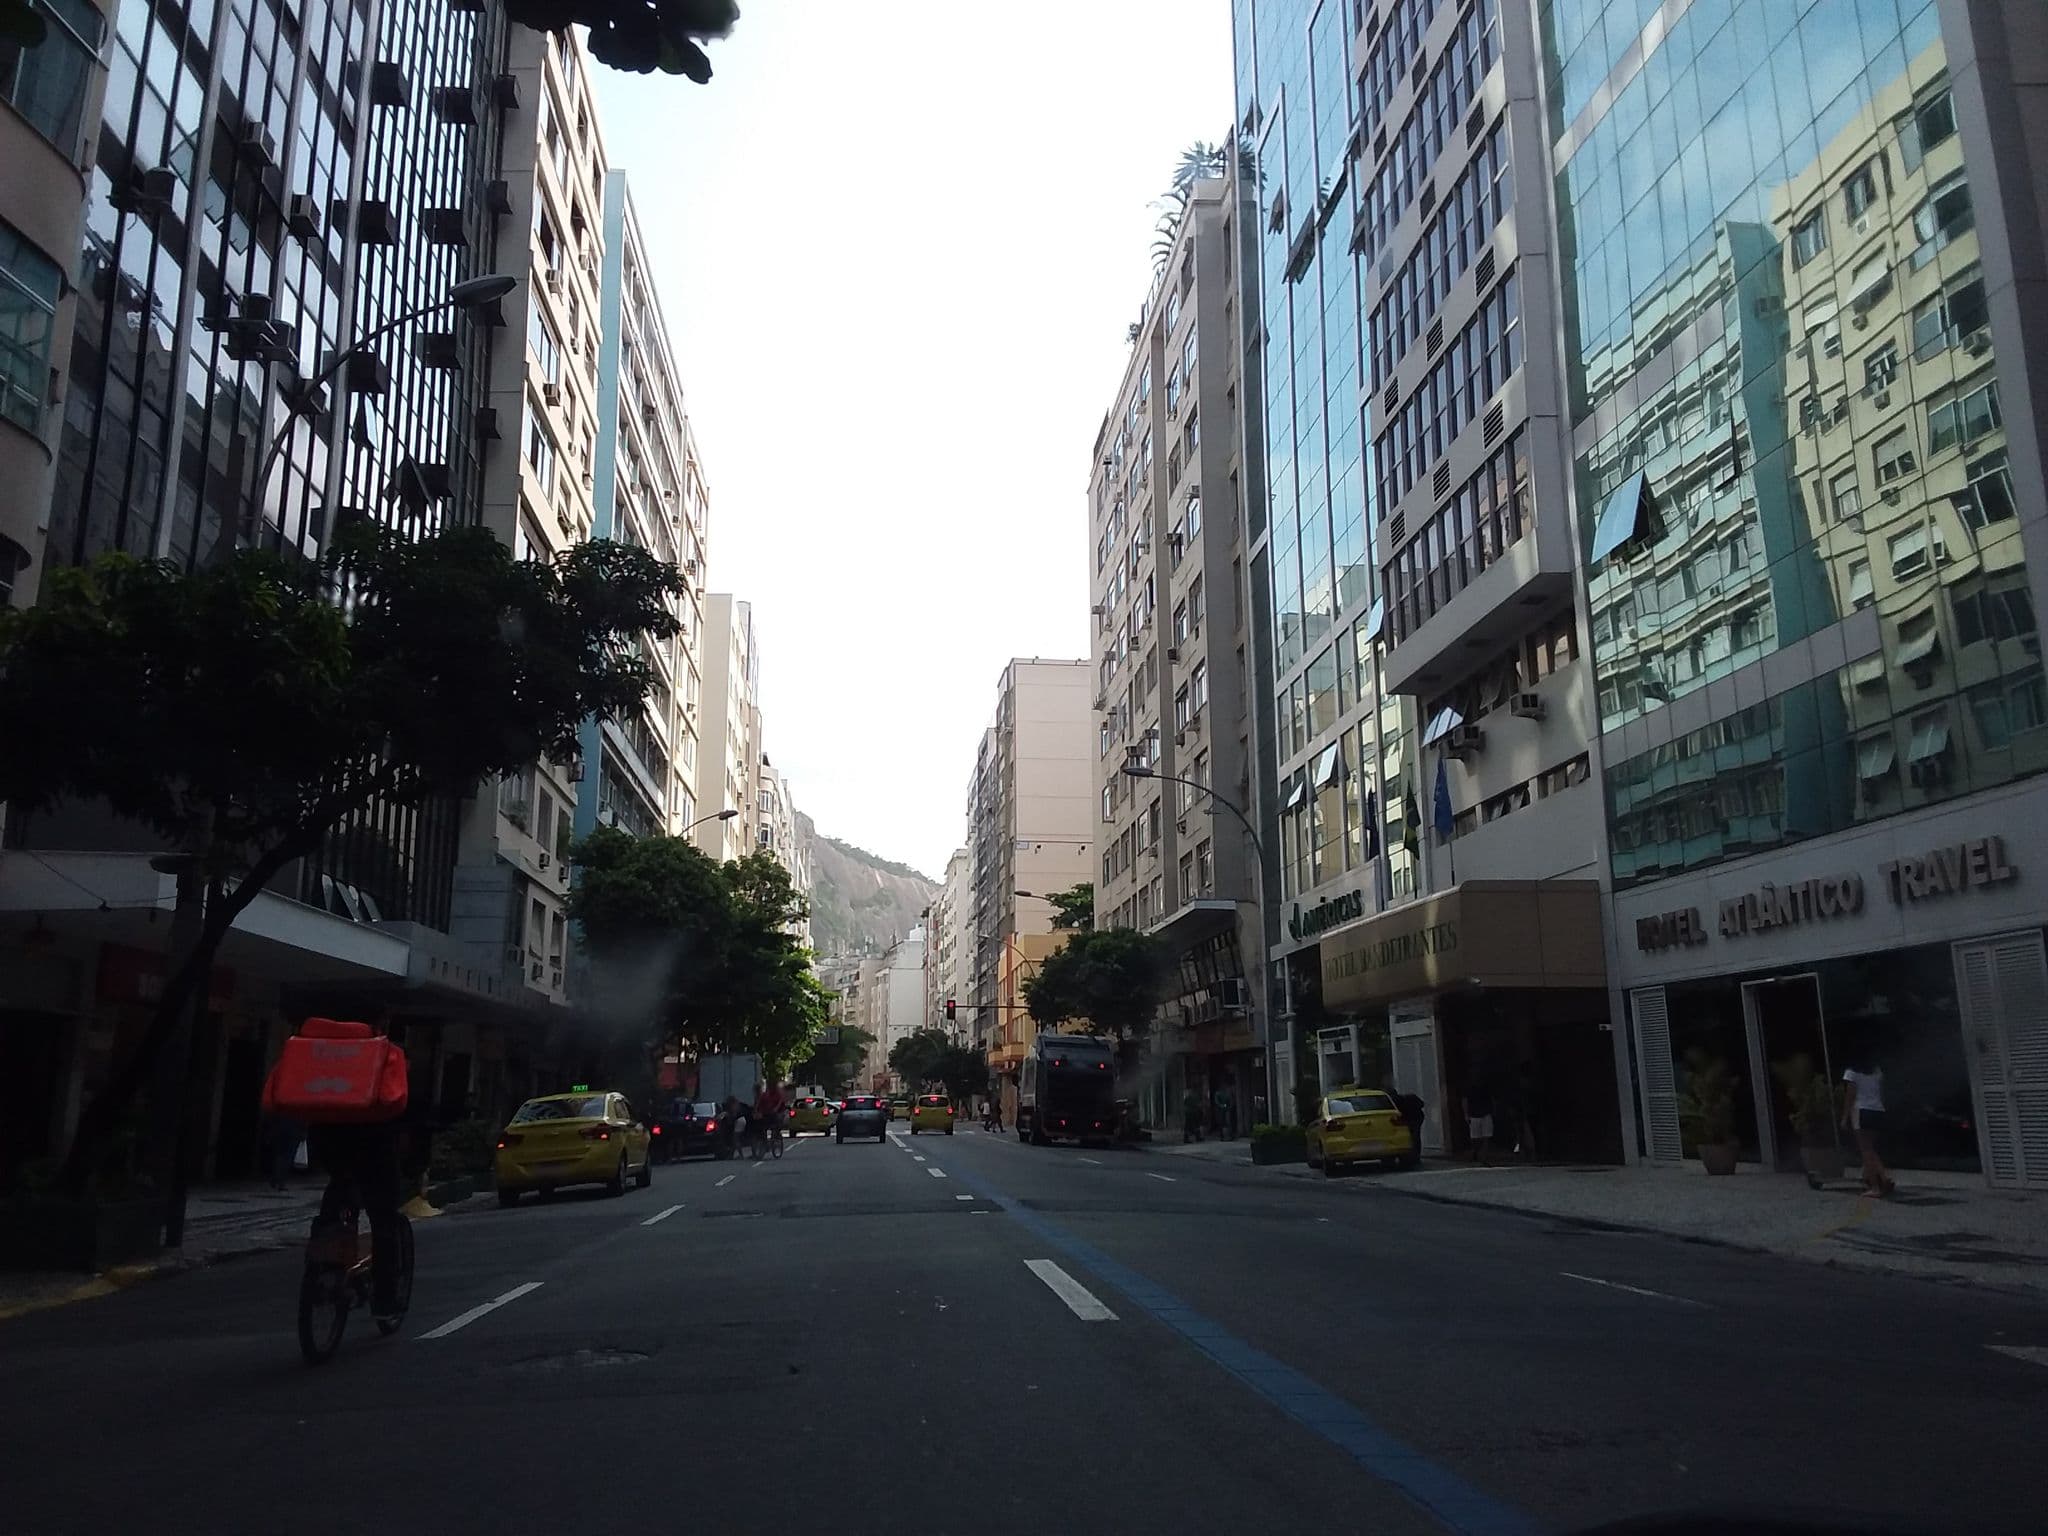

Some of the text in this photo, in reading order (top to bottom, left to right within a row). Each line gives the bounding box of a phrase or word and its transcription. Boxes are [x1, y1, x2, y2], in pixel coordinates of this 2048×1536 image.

[1636, 907, 1707, 951] HOTEL
[1878, 835, 2017, 904] TRAVEL
[1326, 920, 1457, 982] HOTEL BANDEIRANTES
[572, 1084, 588, 1092] TAXI
